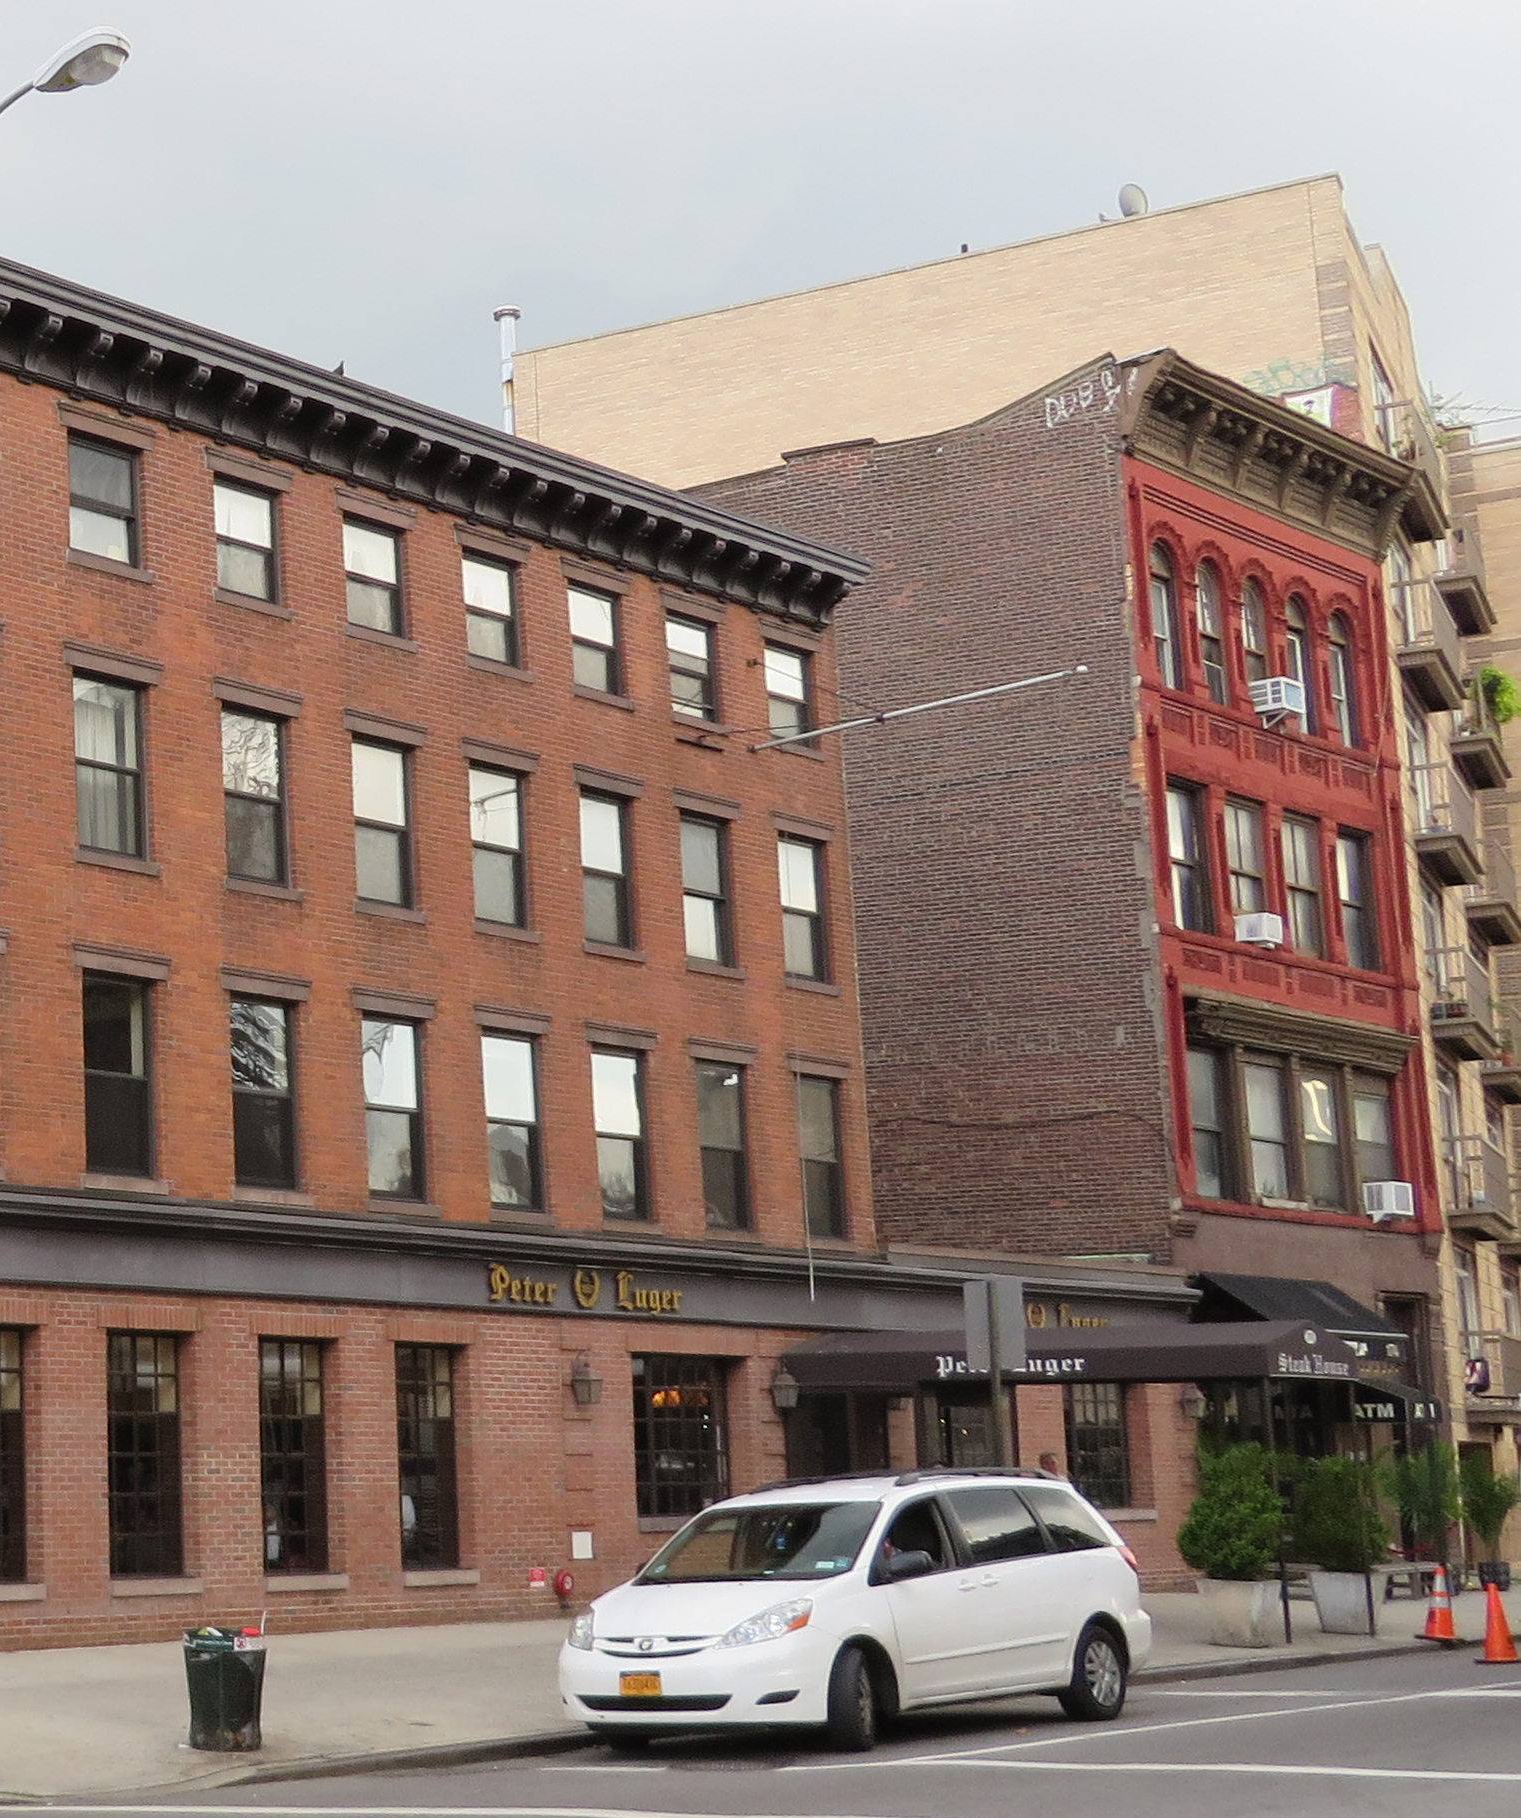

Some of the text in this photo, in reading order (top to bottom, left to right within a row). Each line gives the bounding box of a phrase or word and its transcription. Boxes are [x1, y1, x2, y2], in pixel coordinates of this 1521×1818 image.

[488, 1263, 682, 1315] Peter Luger
[1277, 1352, 1311, 1373] Steak
[1312, 1353, 1349, 1376] House
[1354, 1402, 1394, 1418] ATM
